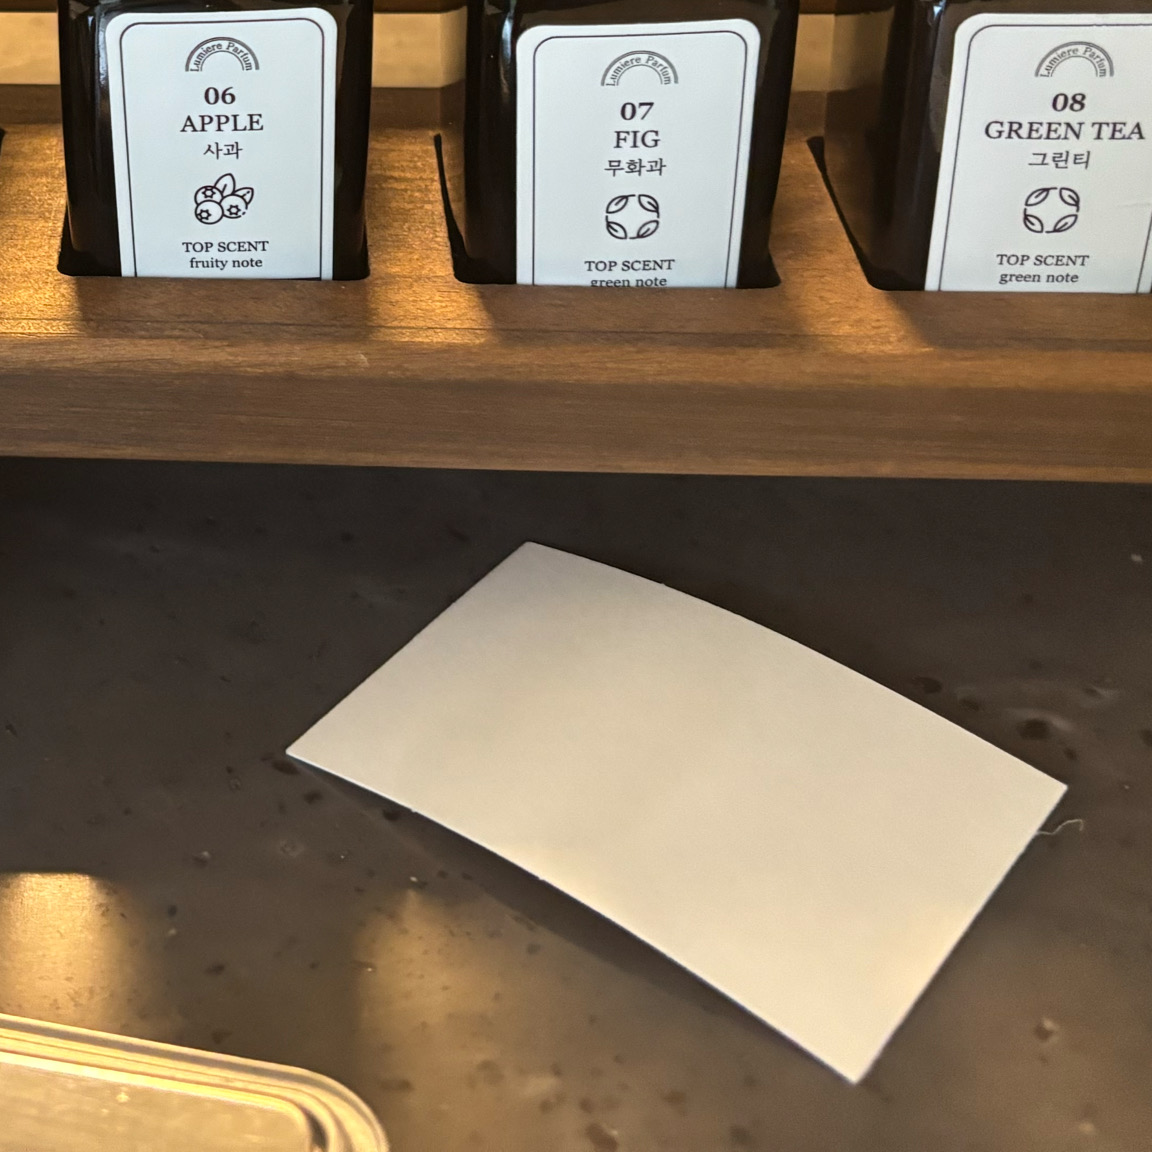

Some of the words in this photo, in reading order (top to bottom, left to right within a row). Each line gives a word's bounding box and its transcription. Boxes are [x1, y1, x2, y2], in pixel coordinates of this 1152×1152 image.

[204, 87, 236, 105] 06
[1052, 93, 1087, 112] 08
[620, 102, 655, 120] 07
[180, 113, 264, 133] APPLE
[984, 121, 1085, 141] GREEN
[1091, 121, 1145, 141] TEA
[613, 130, 661, 149] FIG
[203, 141, 244, 160] 사과
[604, 158, 667, 177] 무화과
[1028, 150, 1091, 170] 그린티
[182, 241, 214, 253] TOP
[217, 240, 269, 252] SCENT
[189, 257, 228, 271] fruity
[232, 258, 263, 268] note
[584, 260, 617, 272] TOP
[621, 259, 675, 271] SCENT
[996, 254, 1030, 266] TOP
[1033, 254, 1090, 267] SCENT
[635, 277, 667, 287] note
[999, 272, 1041, 285] green
[1046, 272, 1079, 283] note
